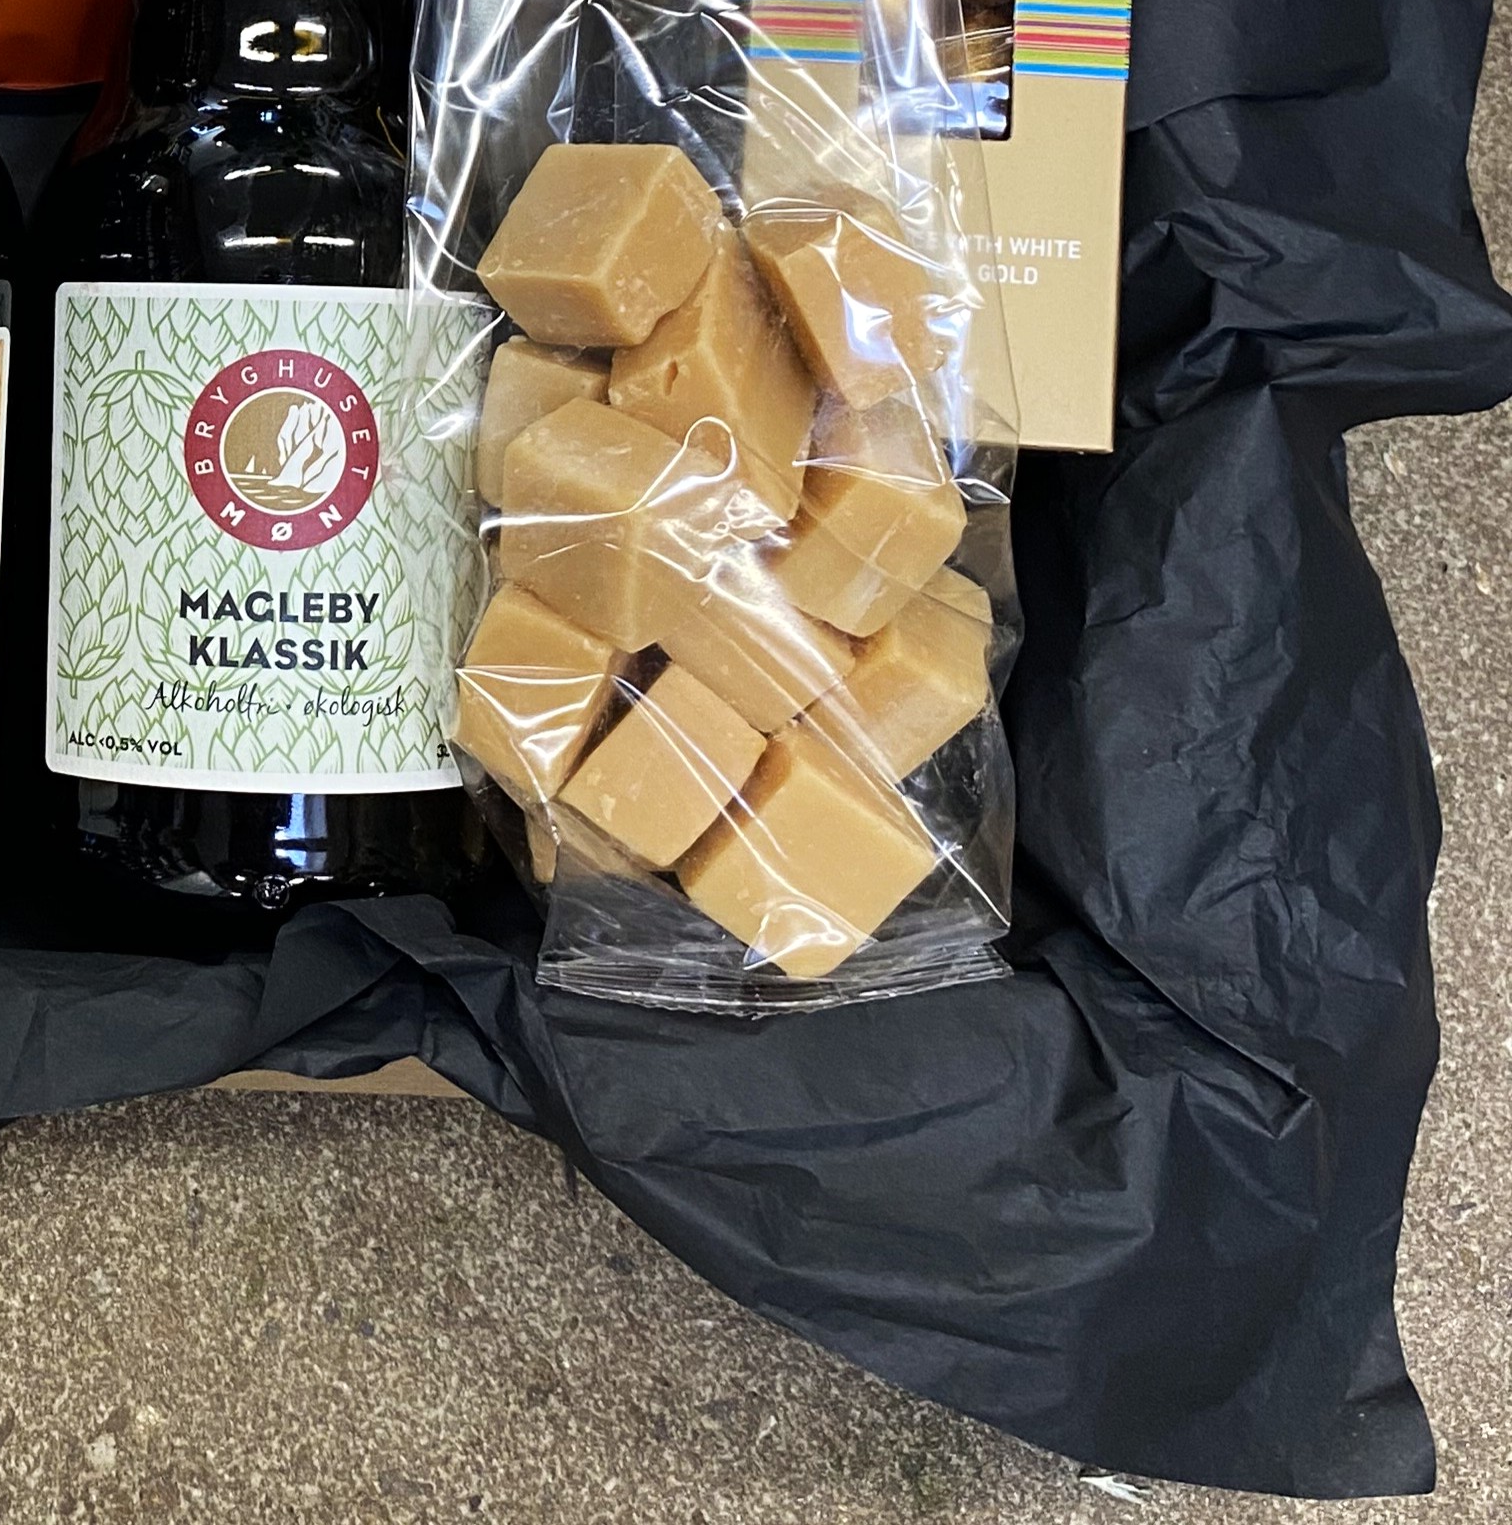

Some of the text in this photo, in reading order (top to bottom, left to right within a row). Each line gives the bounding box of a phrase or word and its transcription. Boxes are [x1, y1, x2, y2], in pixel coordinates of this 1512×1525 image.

[1009, 237, 1082, 259] WHITE
[978, 264, 1039, 285] GOLD
[194, 358, 371, 481] BRYGHUSET
[220, 501, 343, 543] MØN
[179, 588, 379, 624] MAGLEBY
[188, 635, 368, 671] KLASSIK
[303, 683, 406, 727] økologisk
[68, 730, 95, 748] ALC
[147, 740, 183, 757] VOL
